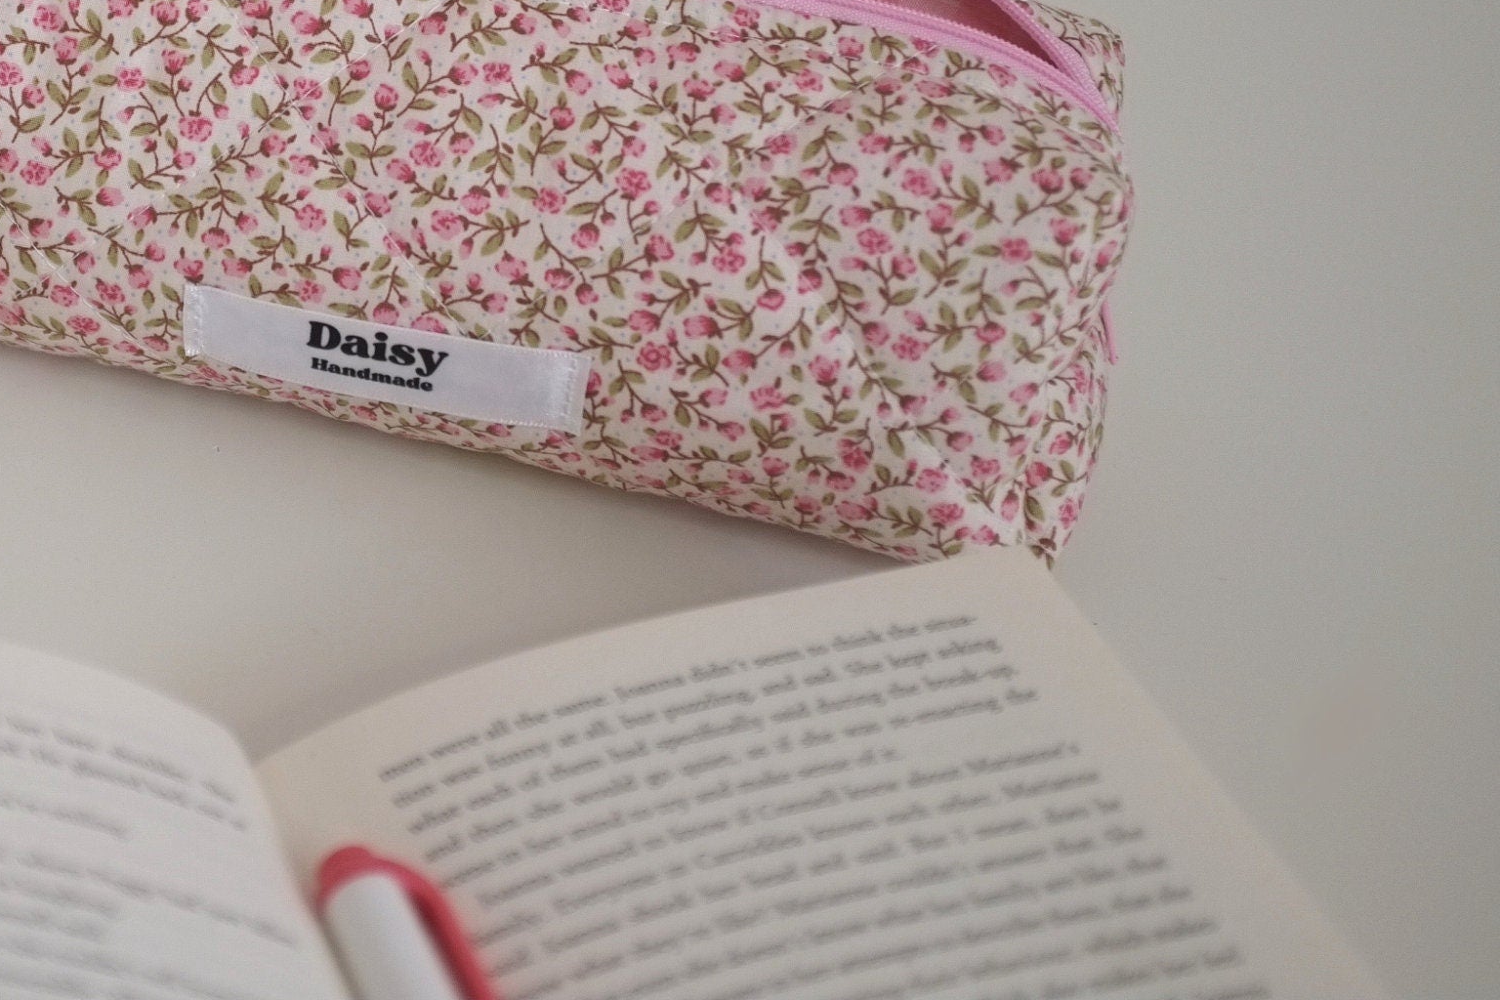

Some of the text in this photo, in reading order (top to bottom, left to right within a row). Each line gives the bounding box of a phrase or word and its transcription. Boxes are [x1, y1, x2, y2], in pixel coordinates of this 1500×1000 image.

[307, 320, 449, 377] Daisy
[311, 357, 433, 392] Handmade
[483, 718, 511, 740] all
[513, 710, 550, 729] the
[688, 659, 748, 682] didn't
[752, 648, 804, 668] seem
[806, 643, 830, 658] to
[831, 629, 884, 652] think
[886, 623, 921, 639] the
[761, 675, 797, 696] and
[844, 661, 883, 676] She
[886, 651, 930, 669] kept
[937, 637, 1003, 659] asking
[607, 740, 649, 762] had
[770, 702, 811, 723] said
[816, 691, 886, 714] during
[887, 682, 919, 698] the
[1004, 687, 1039, 705] the
